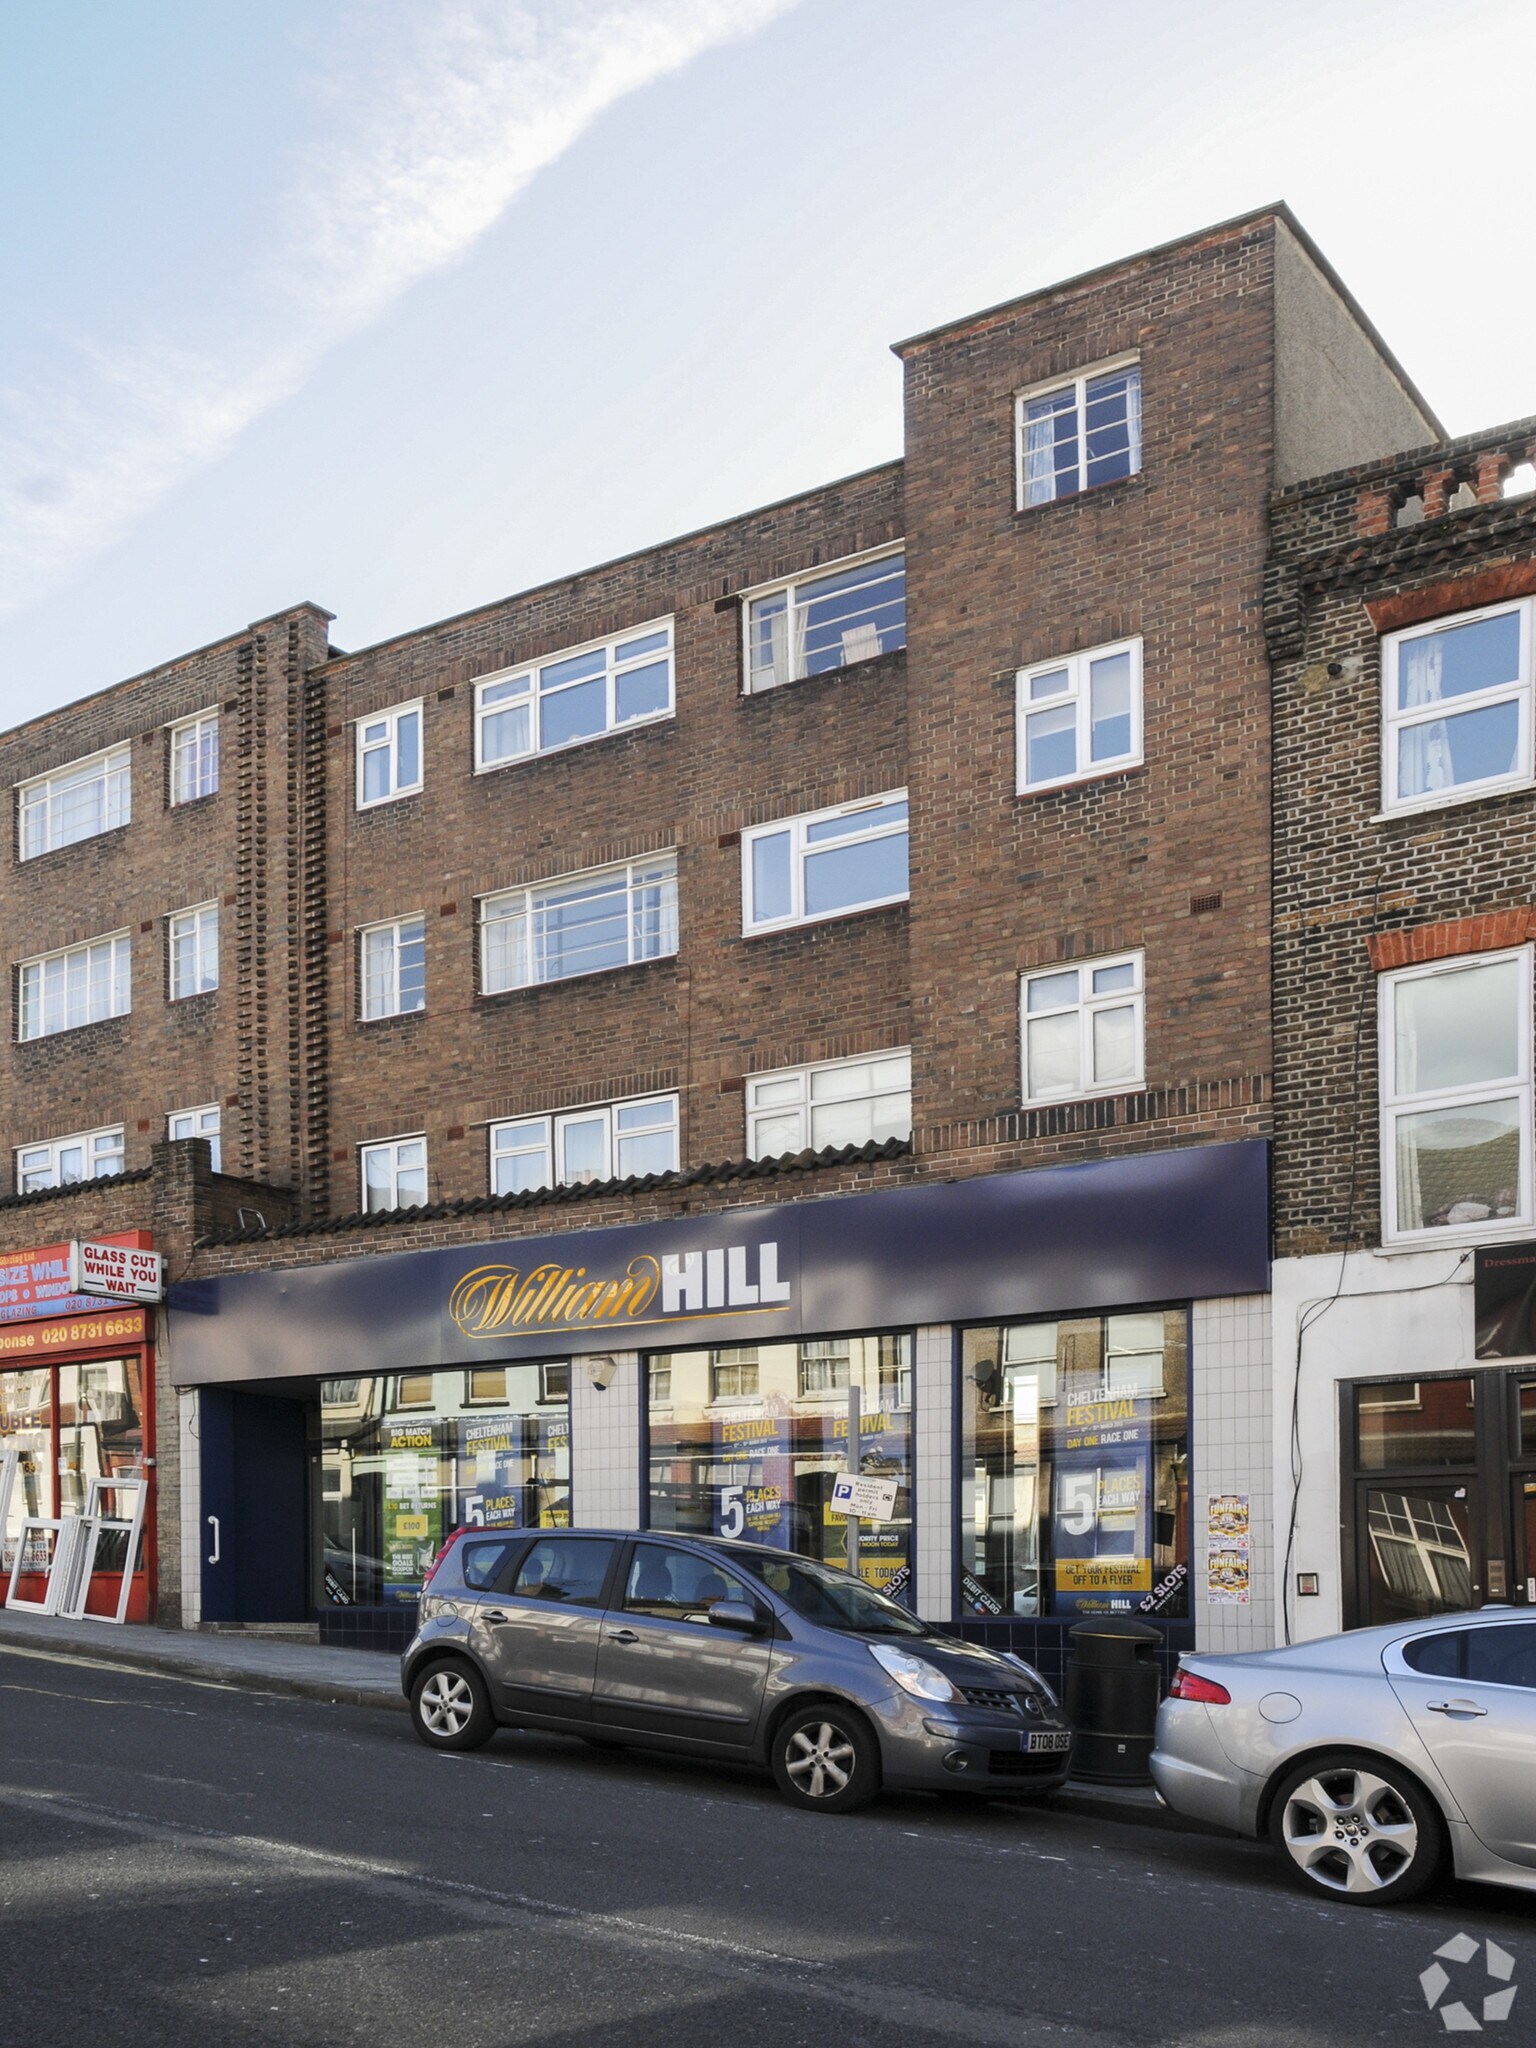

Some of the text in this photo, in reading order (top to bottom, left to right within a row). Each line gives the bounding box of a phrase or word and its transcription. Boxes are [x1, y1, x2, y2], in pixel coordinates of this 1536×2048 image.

[84, 1246, 156, 1268] GLASS CUT
[0, 1264, 28, 1288] SIZE
[84, 1261, 157, 1283] WHILE YOU
[35, 1281, 71, 1299] WINDO
[106, 1279, 137, 1294] WAIT
[450, 1242, 791, 1332] William HILL
[1, 1305, 37, 1320] GLAZING
[65, 1299, 82, 1311] 020
[42, 1326, 68, 1345] 020
[70, 1321, 103, 1341] 8731
[105, 1316, 142, 1336] 6633
[1067, 1383, 1139, 1407] CHELTENHAM
[1066, 1398, 1138, 1427] FESTIVAL
[390, 1427, 432, 1437] BIG MATCH
[466, 1422, 513, 1441] CHELTENHAM
[722, 1419, 779, 1443] FESTIVAL
[833, 1412, 895, 1438] FETIVAL
[390, 1435, 432, 1448] ACTION
[466, 1435, 512, 1457] FESTIVAL
[547, 1435, 568, 1453] FES
[1067, 1429, 1139, 1450] DAY ONE RACE ONE
[746, 1487, 782, 1502] PLACES
[855, 1482, 883, 1490] Resident
[1097, 1474, 1142, 1495] PLACES
[486, 1496, 516, 1511] PLACES
[746, 1499, 781, 1514] EACH WAY
[1064, 1474, 1093, 1536] 5
[1097, 1489, 1141, 1509] EACH WAY
[486, 1507, 516, 1521] EACH WAY
[721, 1486, 744, 1539] 5
[403, 1522, 420, 1530] £100
[1065, 1562, 1142, 1575] GET YOUR FESTIVAL
[882, 1565, 911, 1597] SLOTS
[1073, 1574, 1134, 1586] OFF TO A FLYER
[1140, 1563, 1188, 1613] £2 SLOTS
[962, 1577, 982, 1597] DEBIT
[980, 1594, 1001, 1615] CARD
[1111, 1599, 1132, 1609] HILL
[1030, 1734, 1055, 1750] BT08
